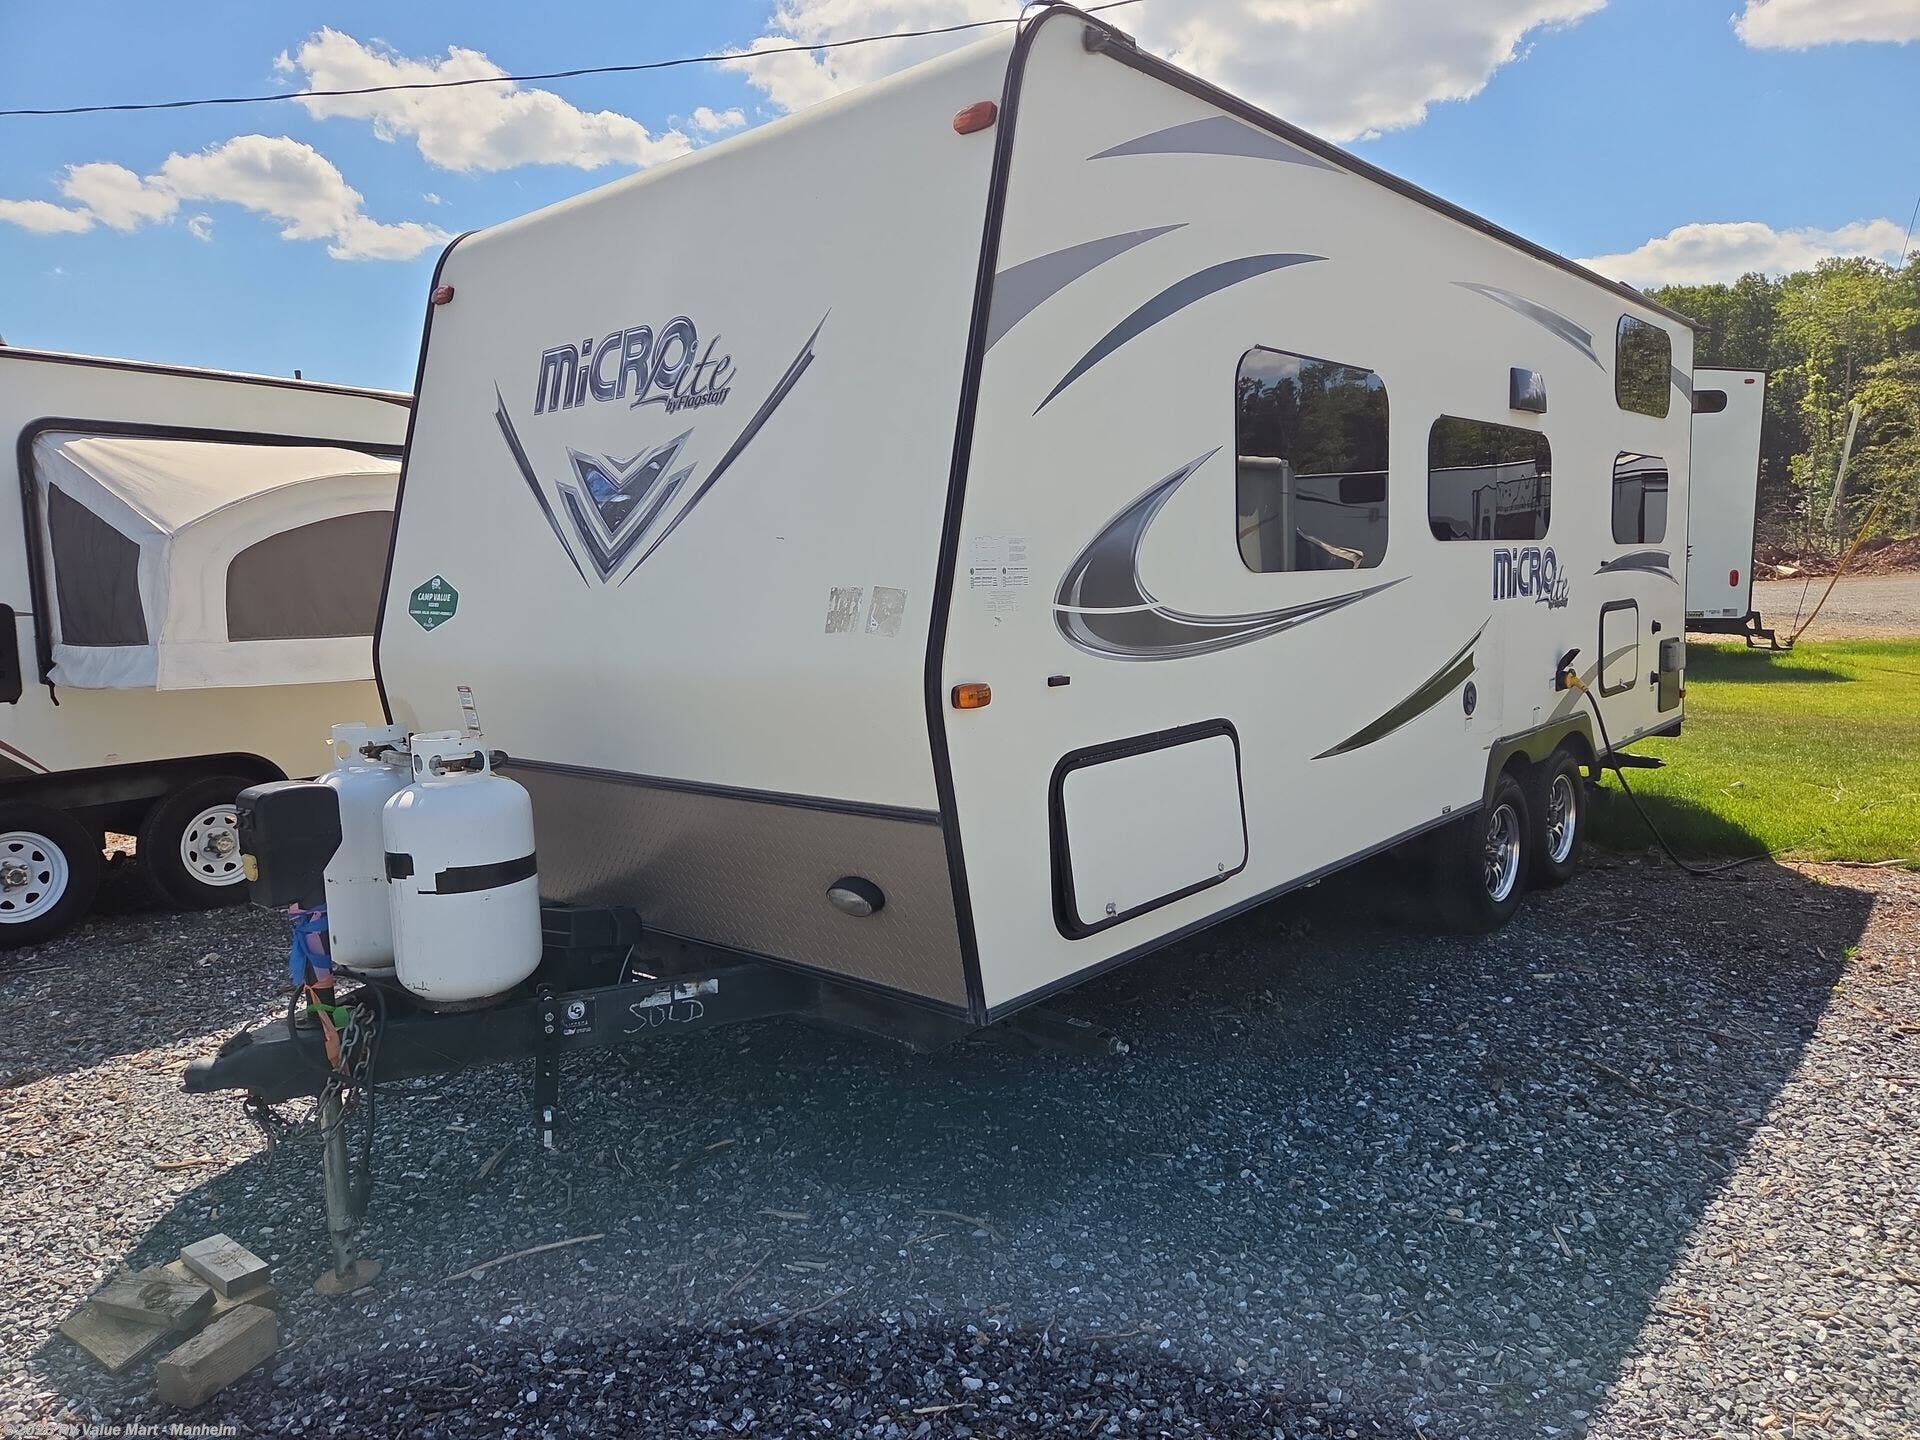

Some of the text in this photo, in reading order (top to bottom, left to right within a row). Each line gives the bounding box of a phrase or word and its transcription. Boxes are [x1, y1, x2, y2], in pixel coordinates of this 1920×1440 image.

[677, 387, 731, 411] Flagstaff
[417, 592, 451, 602] CAMP VALUE
[623, 1000, 704, 1033] SOLD
